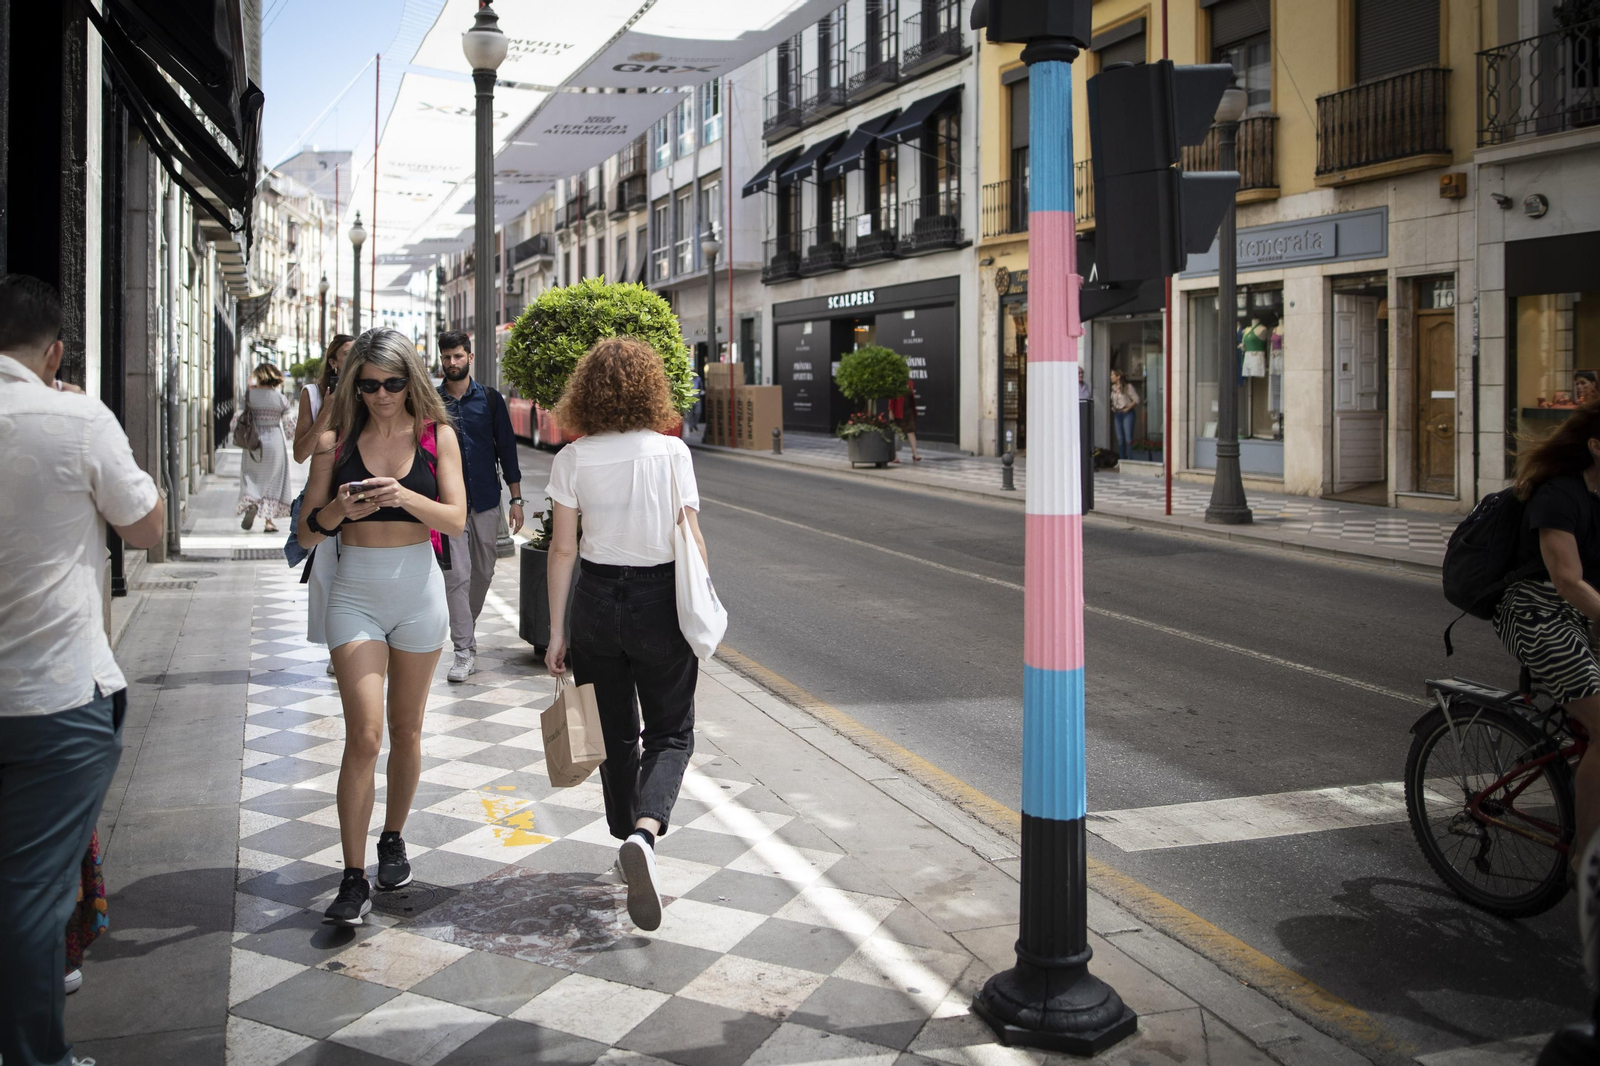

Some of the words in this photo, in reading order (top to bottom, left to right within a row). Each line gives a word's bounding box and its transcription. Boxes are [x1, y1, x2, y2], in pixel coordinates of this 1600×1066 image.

[509, 46, 561, 56] CERV
[1239, 229, 1324, 259] temerata
[828, 290, 875, 309] SCALPERS
[1436, 290, 1455, 308] 10
